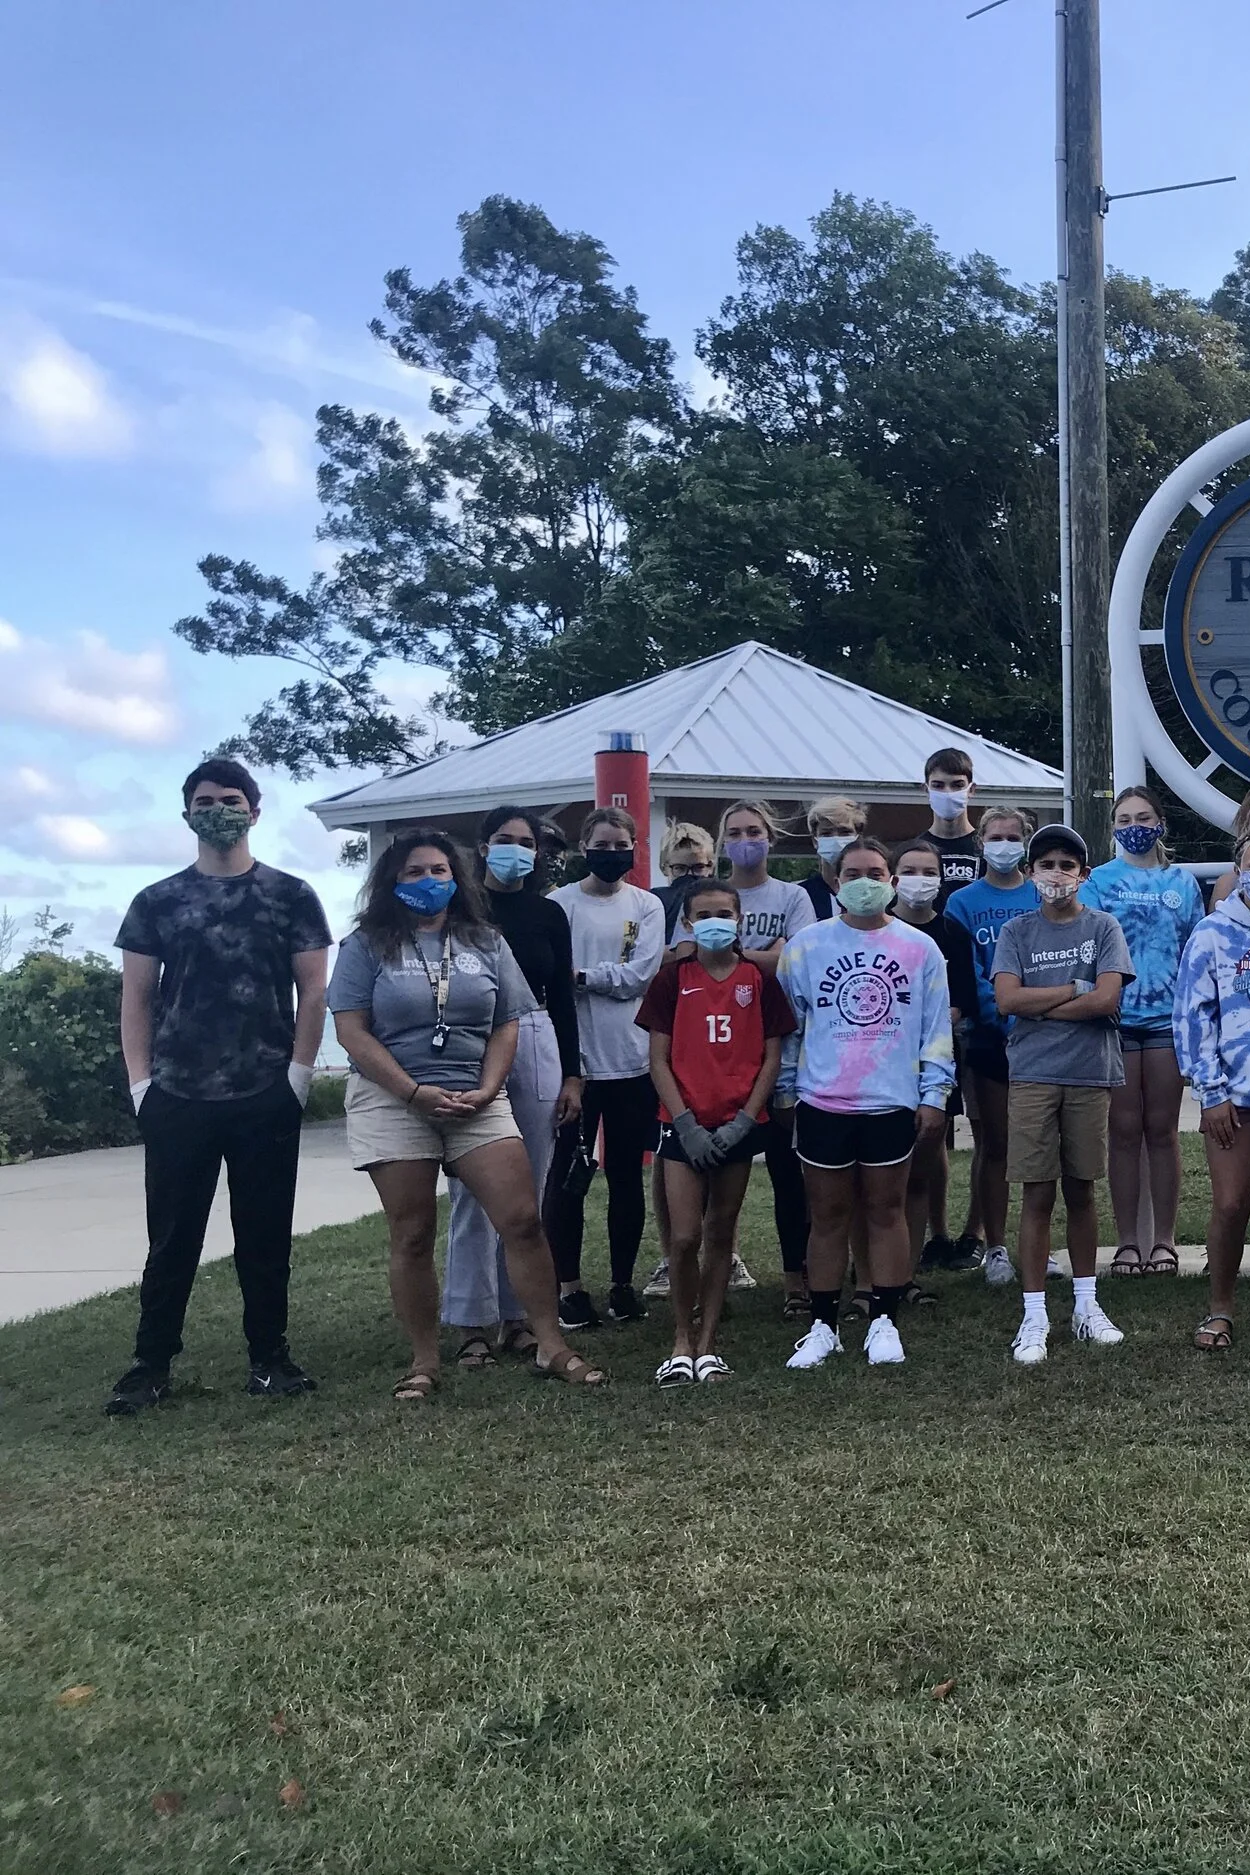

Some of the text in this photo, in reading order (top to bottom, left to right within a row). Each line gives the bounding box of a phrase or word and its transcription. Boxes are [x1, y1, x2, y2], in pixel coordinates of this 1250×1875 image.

[1118, 890, 1160, 901] Interact
[1031, 947, 1079, 964] Interact
[816, 952, 911, 1008] POGUE CREW
[706, 1015, 732, 1043] 13
